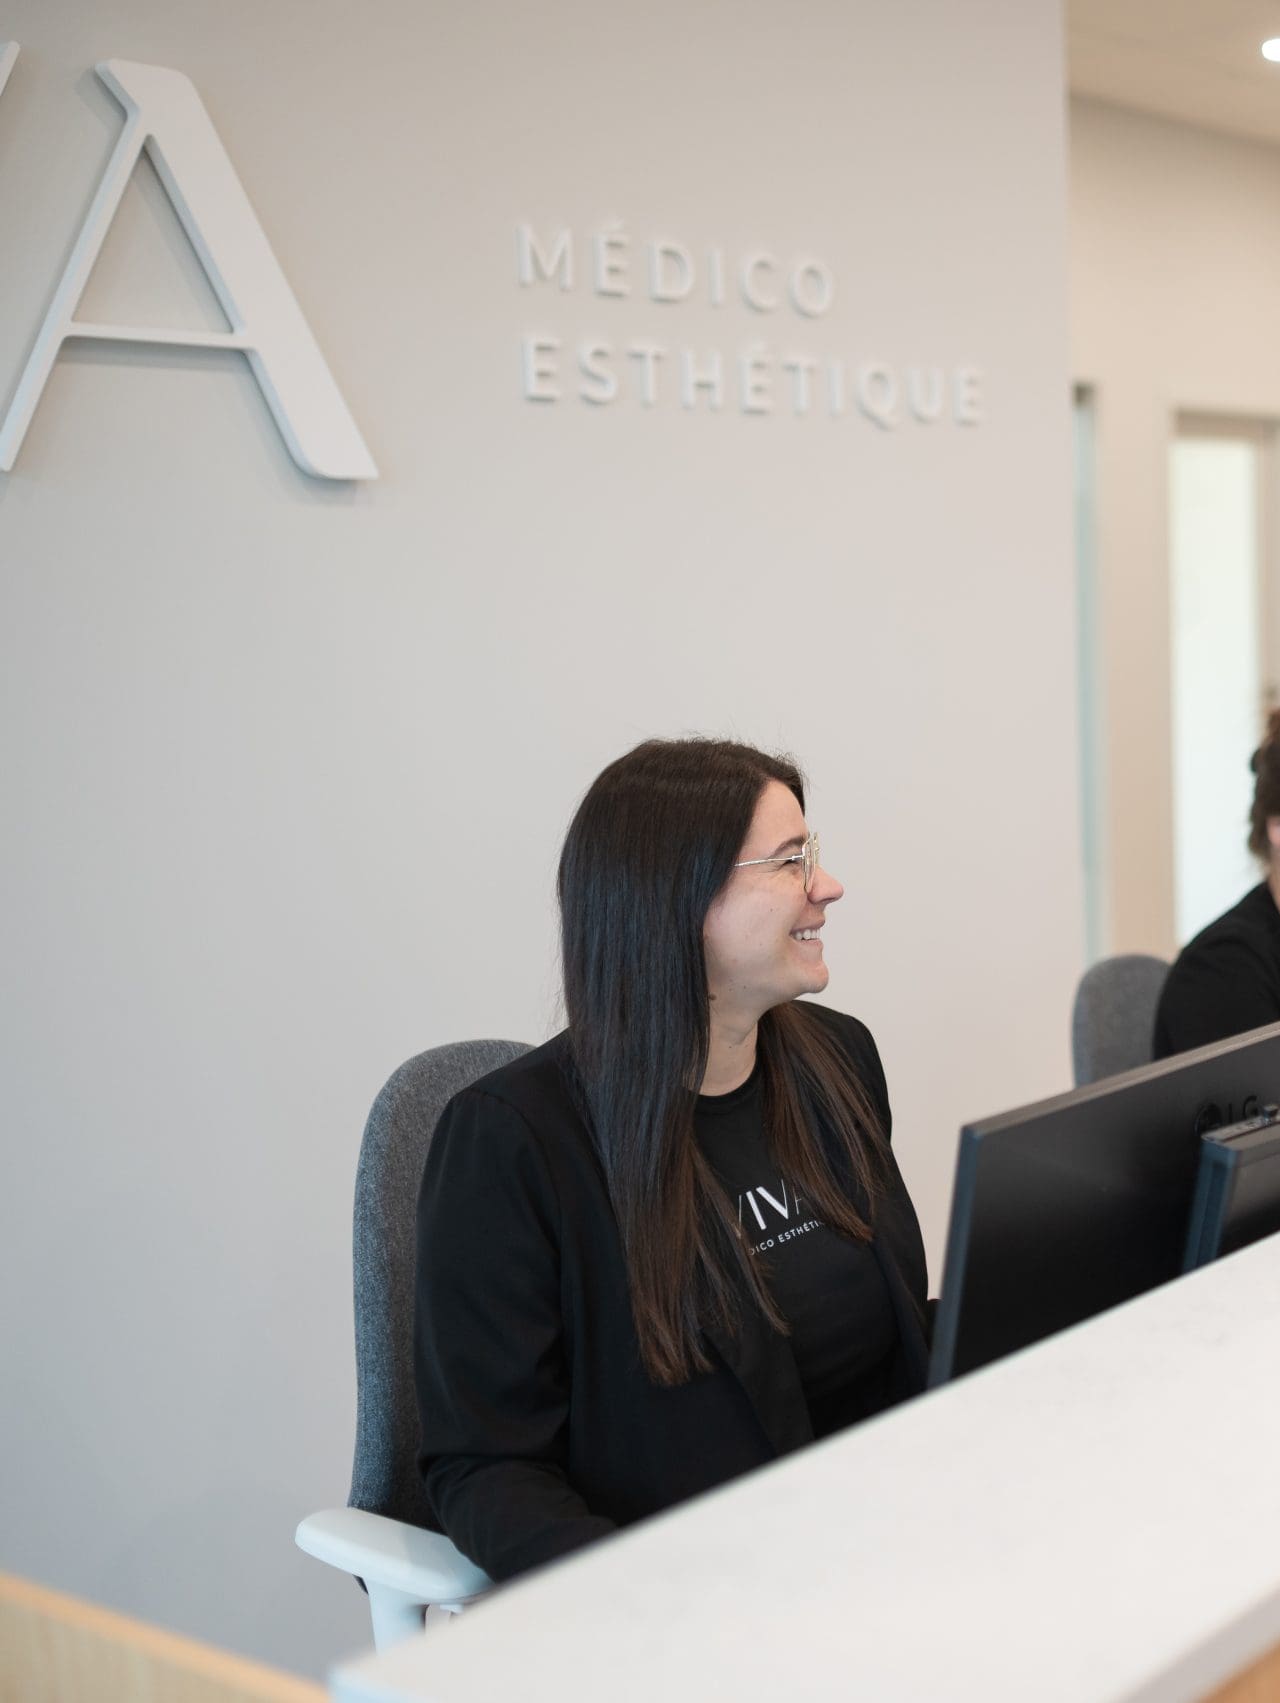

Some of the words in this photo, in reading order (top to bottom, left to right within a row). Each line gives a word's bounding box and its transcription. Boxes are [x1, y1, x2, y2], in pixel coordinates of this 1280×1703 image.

[0, 40, 379, 480] A
[515, 216, 834, 318] MÉDICO
[519, 334, 984, 430] ESTHÉTIQUE
[746, 1238, 775, 1256] DICO
[777, 1219, 824, 1243] ESTHÉTI
